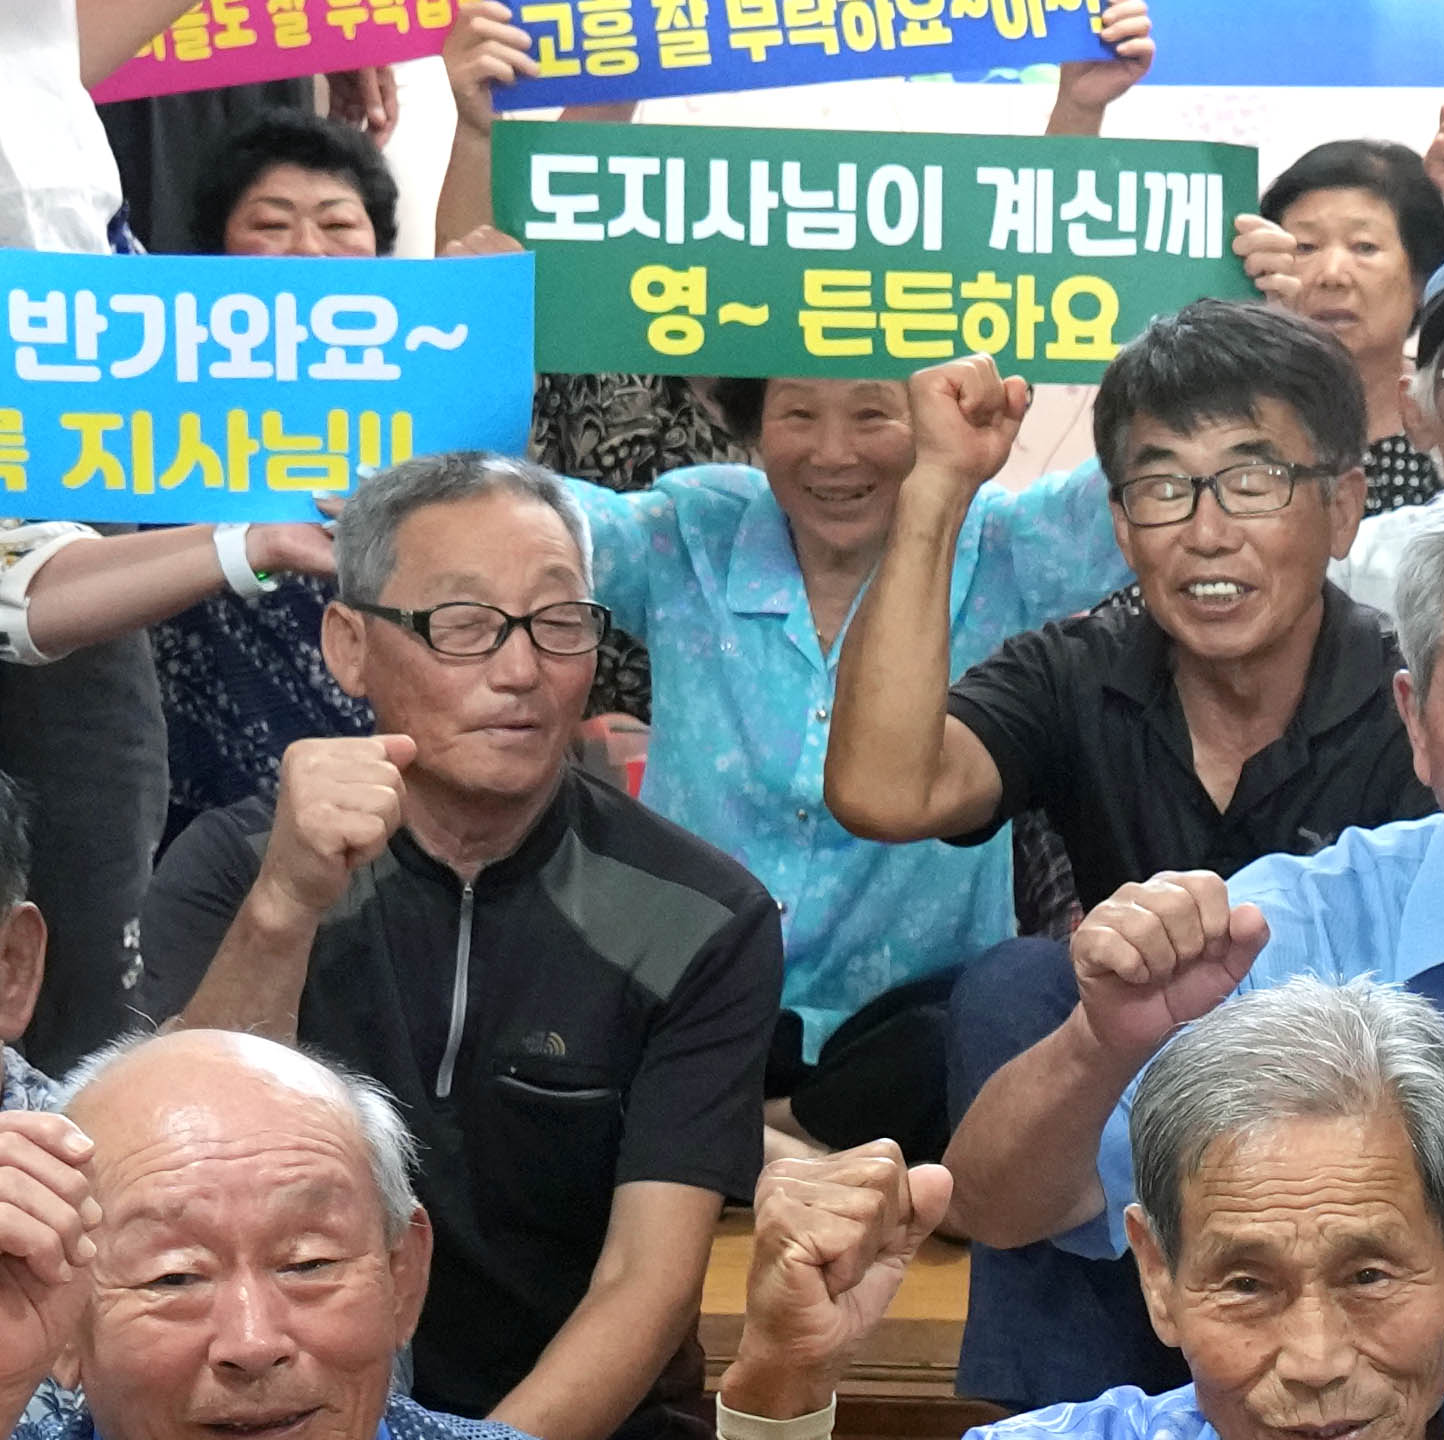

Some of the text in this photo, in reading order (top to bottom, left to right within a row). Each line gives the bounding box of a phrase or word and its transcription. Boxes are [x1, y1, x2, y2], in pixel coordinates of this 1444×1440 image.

[522, 0, 638, 76] 고흥
[653, 0, 708, 67] 잘
[525, 155, 1223, 259] 도지사님이 계신께
[9, 289, 467, 382] 반가와요~
[630, 265, 1119, 361] 영~ 든든하요
